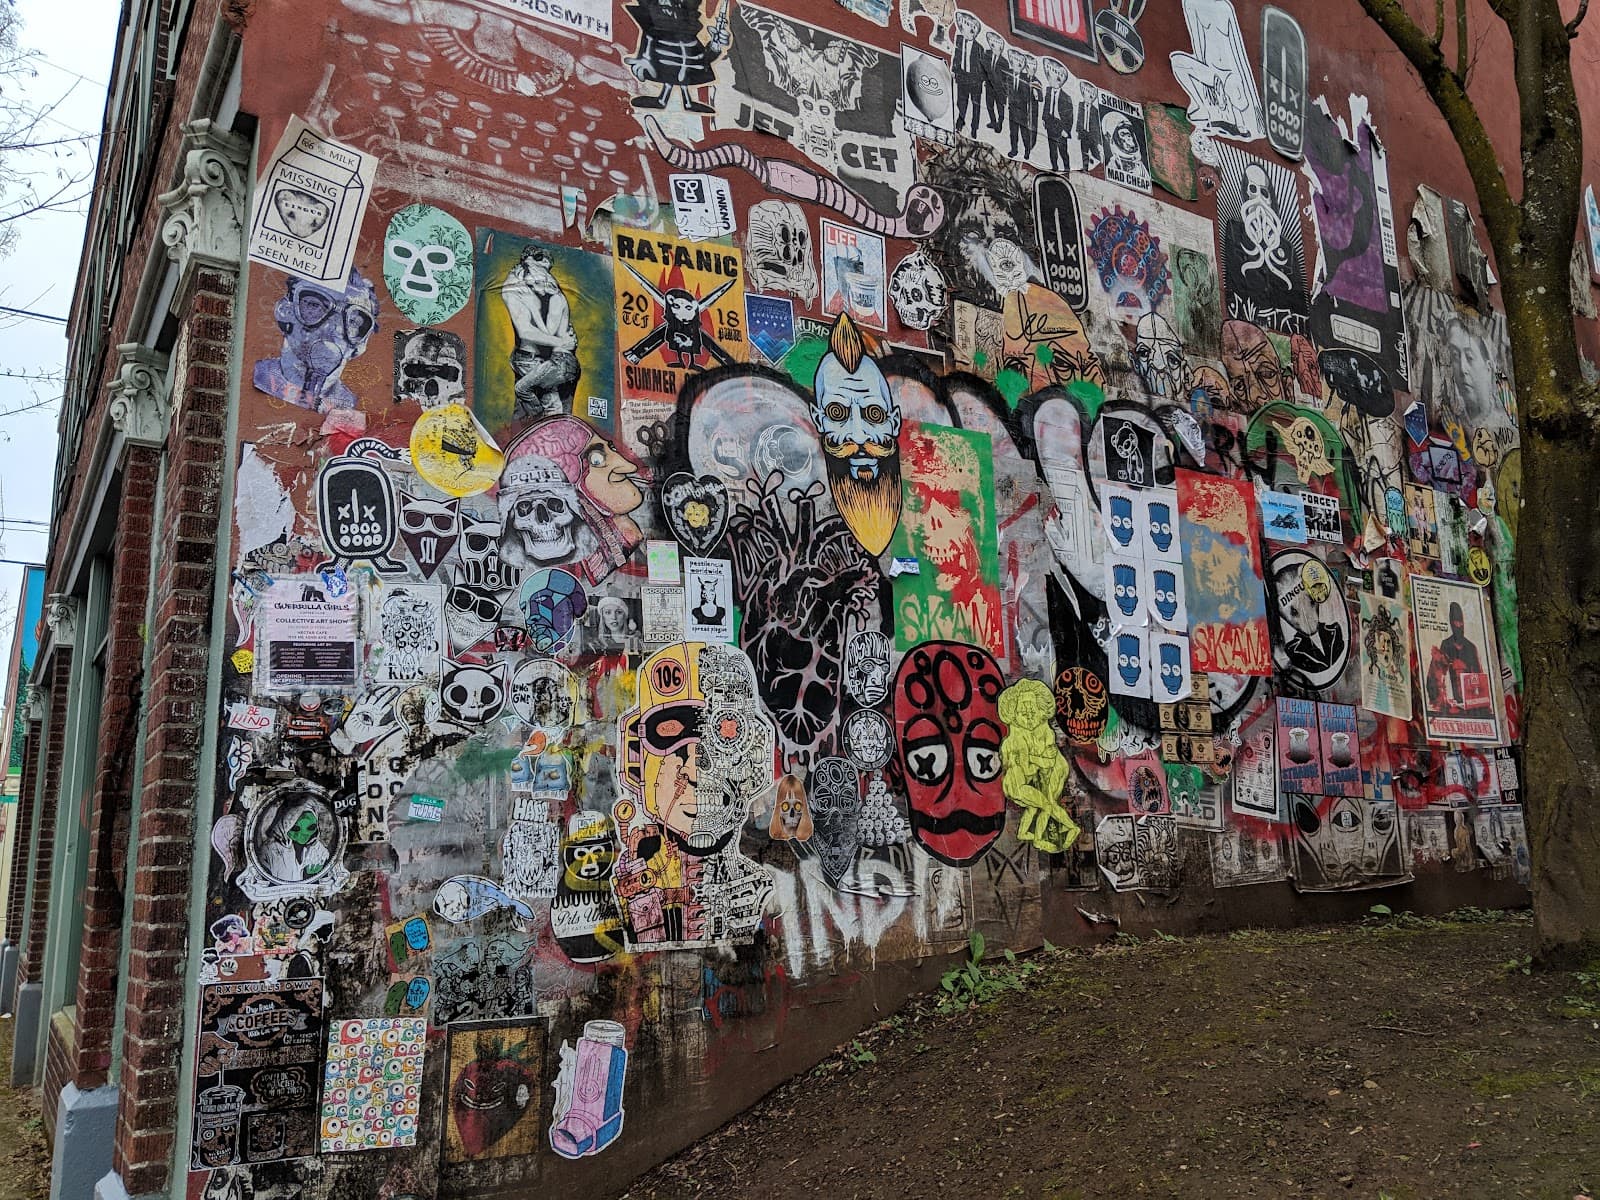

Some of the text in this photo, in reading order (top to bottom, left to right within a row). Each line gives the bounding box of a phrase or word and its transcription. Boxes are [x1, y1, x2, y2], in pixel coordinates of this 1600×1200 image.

[1114, 20, 1129, 39] TRIP
[734, 103, 898, 173] JET CET
[328, 150, 355, 167] MILK
[279, 168, 337, 198] MISSING
[1107, 168, 1150, 190] MAD CHEAP
[259, 230, 324, 260] HAVE YOU
[826, 226, 857, 247] LIFE
[257, 245, 317, 273] SEEN ME?
[617, 235, 738, 278] RATANIC
[622, 291, 648, 312] 20
[717, 308, 740, 328] 18
[625, 365, 676, 394] SUMMER
[1301, 493, 1337, 508] FORGET
[1281, 582, 1305, 607] DINGU
[655, 666, 681, 689] 106
[230, 711, 270, 728] KIND
[247, 705, 260, 715] BE
[334, 798, 357, 810] DUG
[216, 980, 312, 994] RX SKULLS OWN
[235, 1011, 288, 1030] COFFEE
